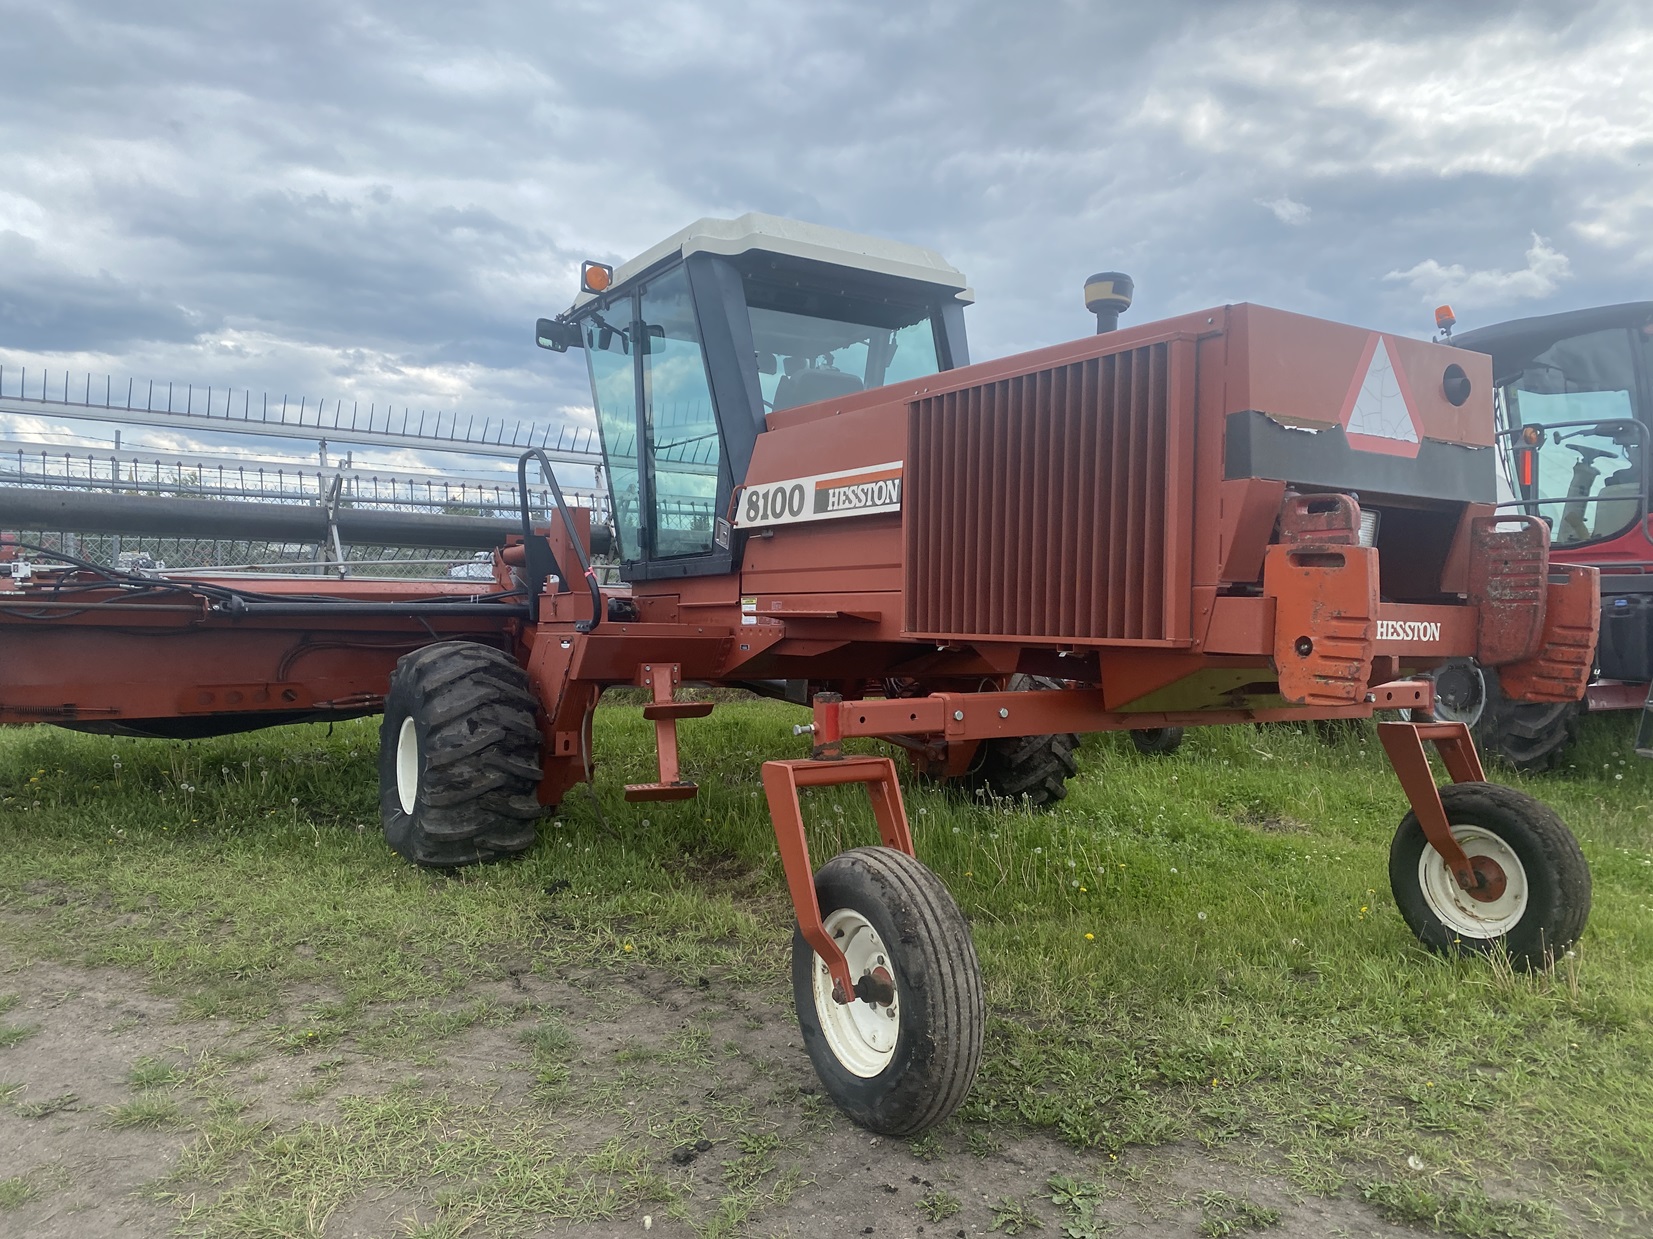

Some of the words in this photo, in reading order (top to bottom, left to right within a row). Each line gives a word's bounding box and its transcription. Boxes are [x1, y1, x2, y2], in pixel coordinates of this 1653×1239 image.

[746, 484, 805, 522] 8100
[827, 479, 900, 511] HESSTON
[1376, 620, 1441, 642] HESSTON
